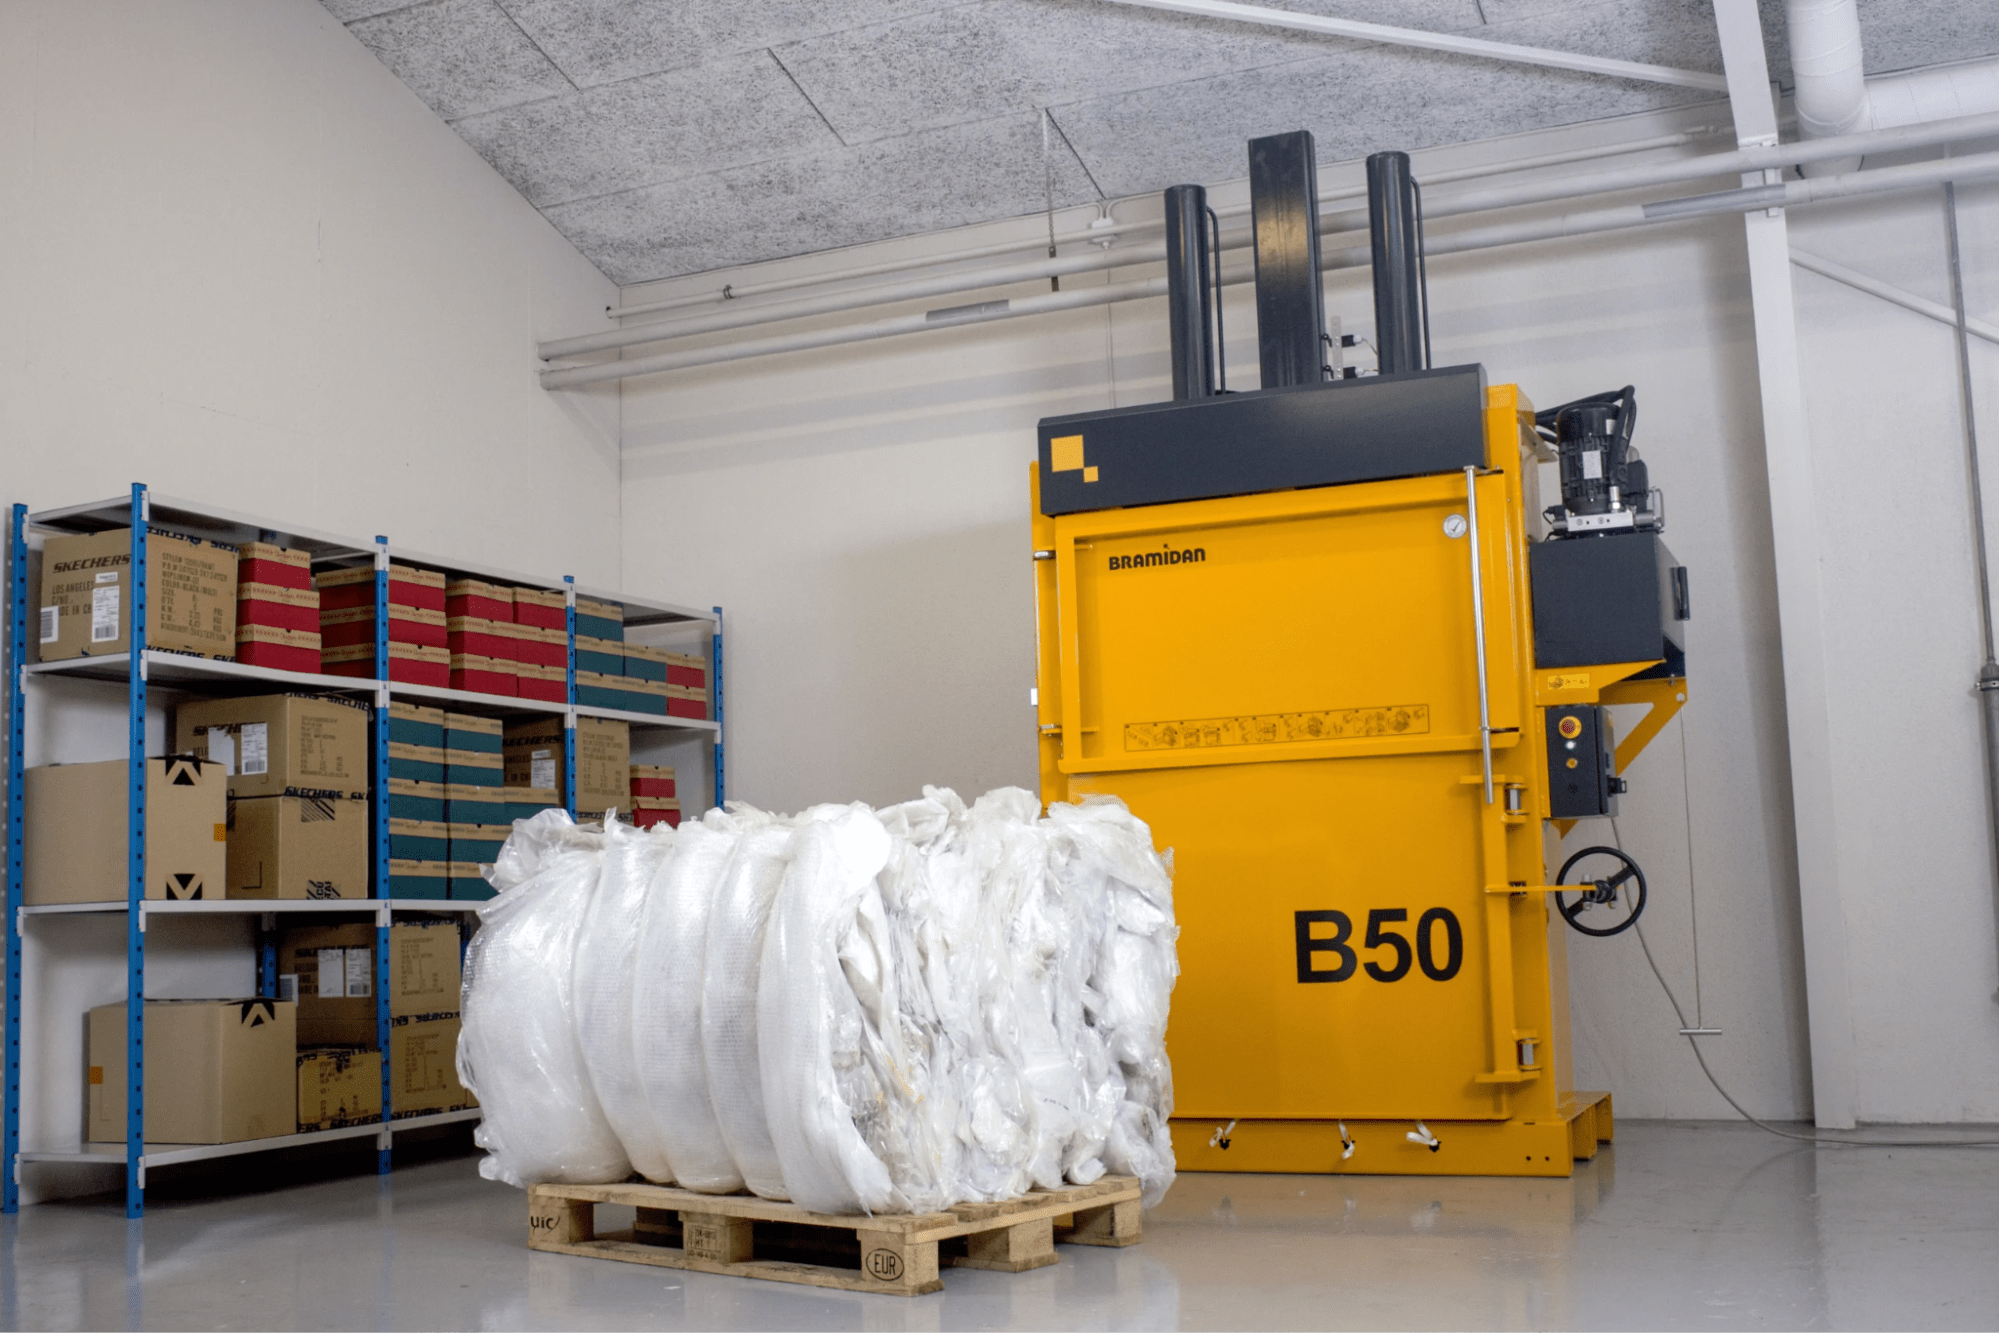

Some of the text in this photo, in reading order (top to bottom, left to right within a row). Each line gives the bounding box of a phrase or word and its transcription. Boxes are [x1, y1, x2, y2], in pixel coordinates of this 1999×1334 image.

[53, 553, 132, 573] SKECHERS
[1109, 544, 1206, 570] BRAMIDAN
[52, 581, 95, 595] LOS ANGELES
[1295, 907, 1463, 983] B50
[874, 1253, 896, 1275] EUR
